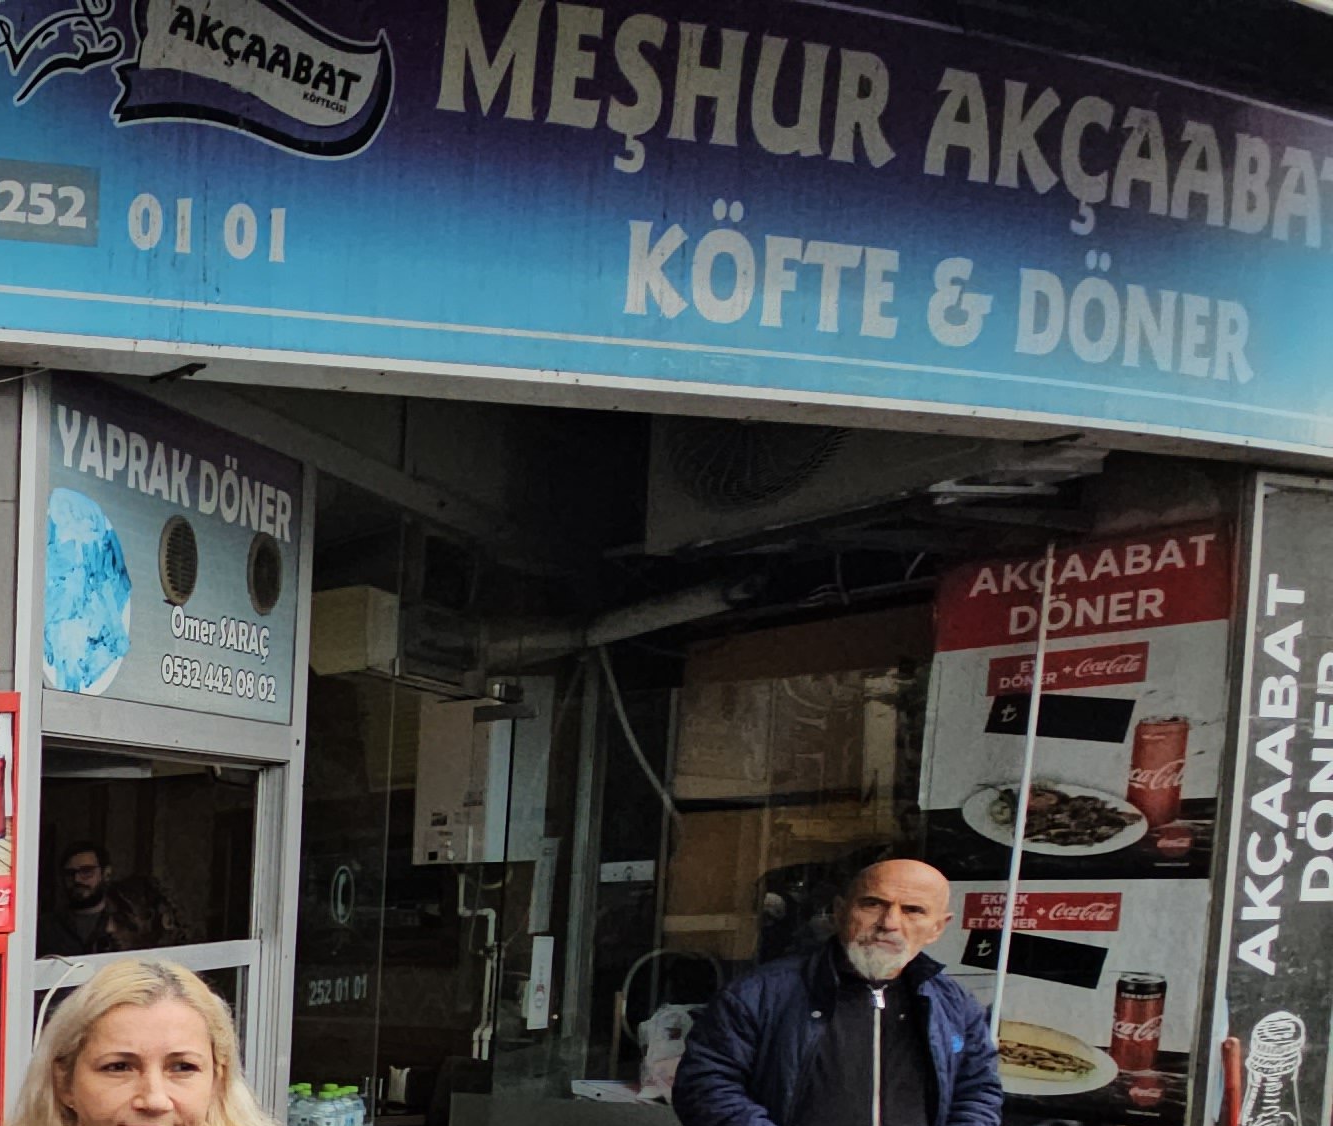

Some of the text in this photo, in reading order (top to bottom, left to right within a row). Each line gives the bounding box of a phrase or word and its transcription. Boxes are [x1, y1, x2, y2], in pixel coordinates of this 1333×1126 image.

[168, 5, 362, 102] AKÇAABAT
[436, 0, 896, 173] MEŞHUR
[128, 192, 192, 254] 01
[223, 203, 286, 263] 01
[623, 198, 1255, 384] KÖFTE & DÖNER
[57, 404, 293, 543] YAPRAK DÖNER
[969, 533, 1216, 599] AKÇAABAT
[218, 616, 271, 665] SARAÇ
[1008, 587, 1165, 636] DÖNER
[160, 654, 277, 703] 0532 442 08 02
[1074, 653, 1143, 679] Coca-Cola
[1237, 573, 1306, 977] AKÇAABAT
[1048, 902, 1118, 922] Coca-Cola
